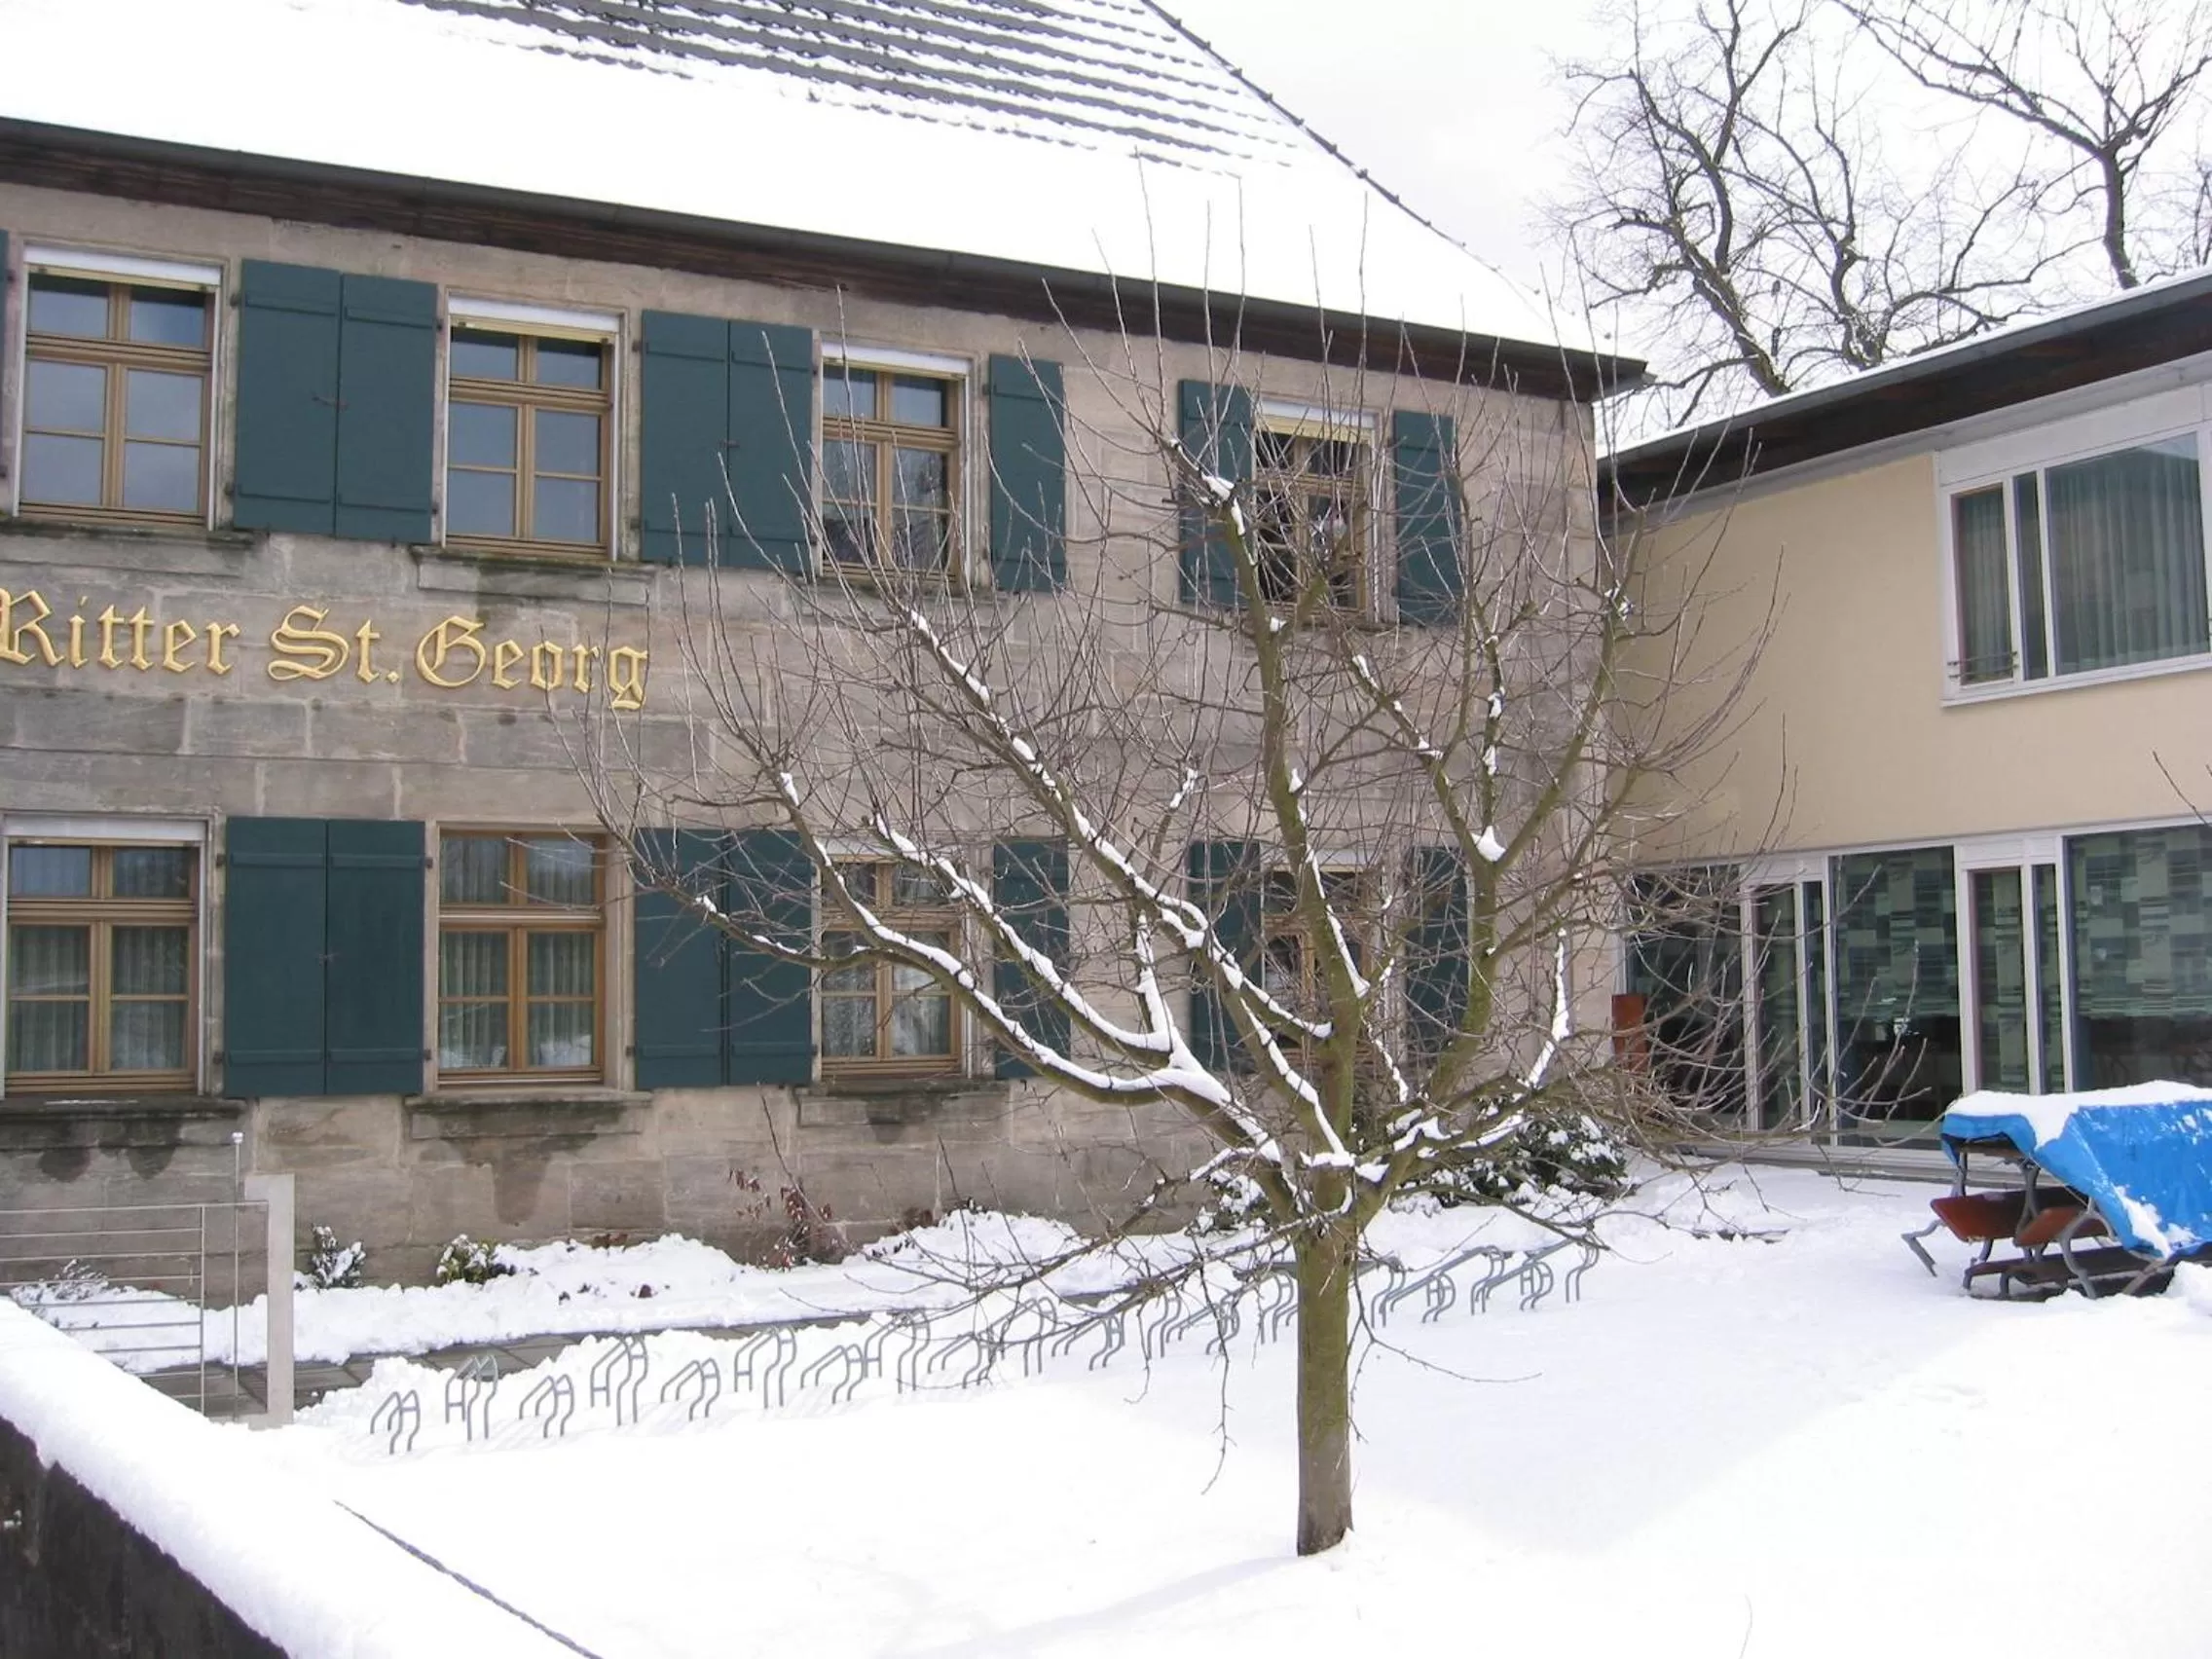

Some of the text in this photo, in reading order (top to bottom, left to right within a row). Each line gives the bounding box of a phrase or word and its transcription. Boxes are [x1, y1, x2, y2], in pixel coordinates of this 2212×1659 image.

[0, 588, 649, 710] Ritter St. Georg
